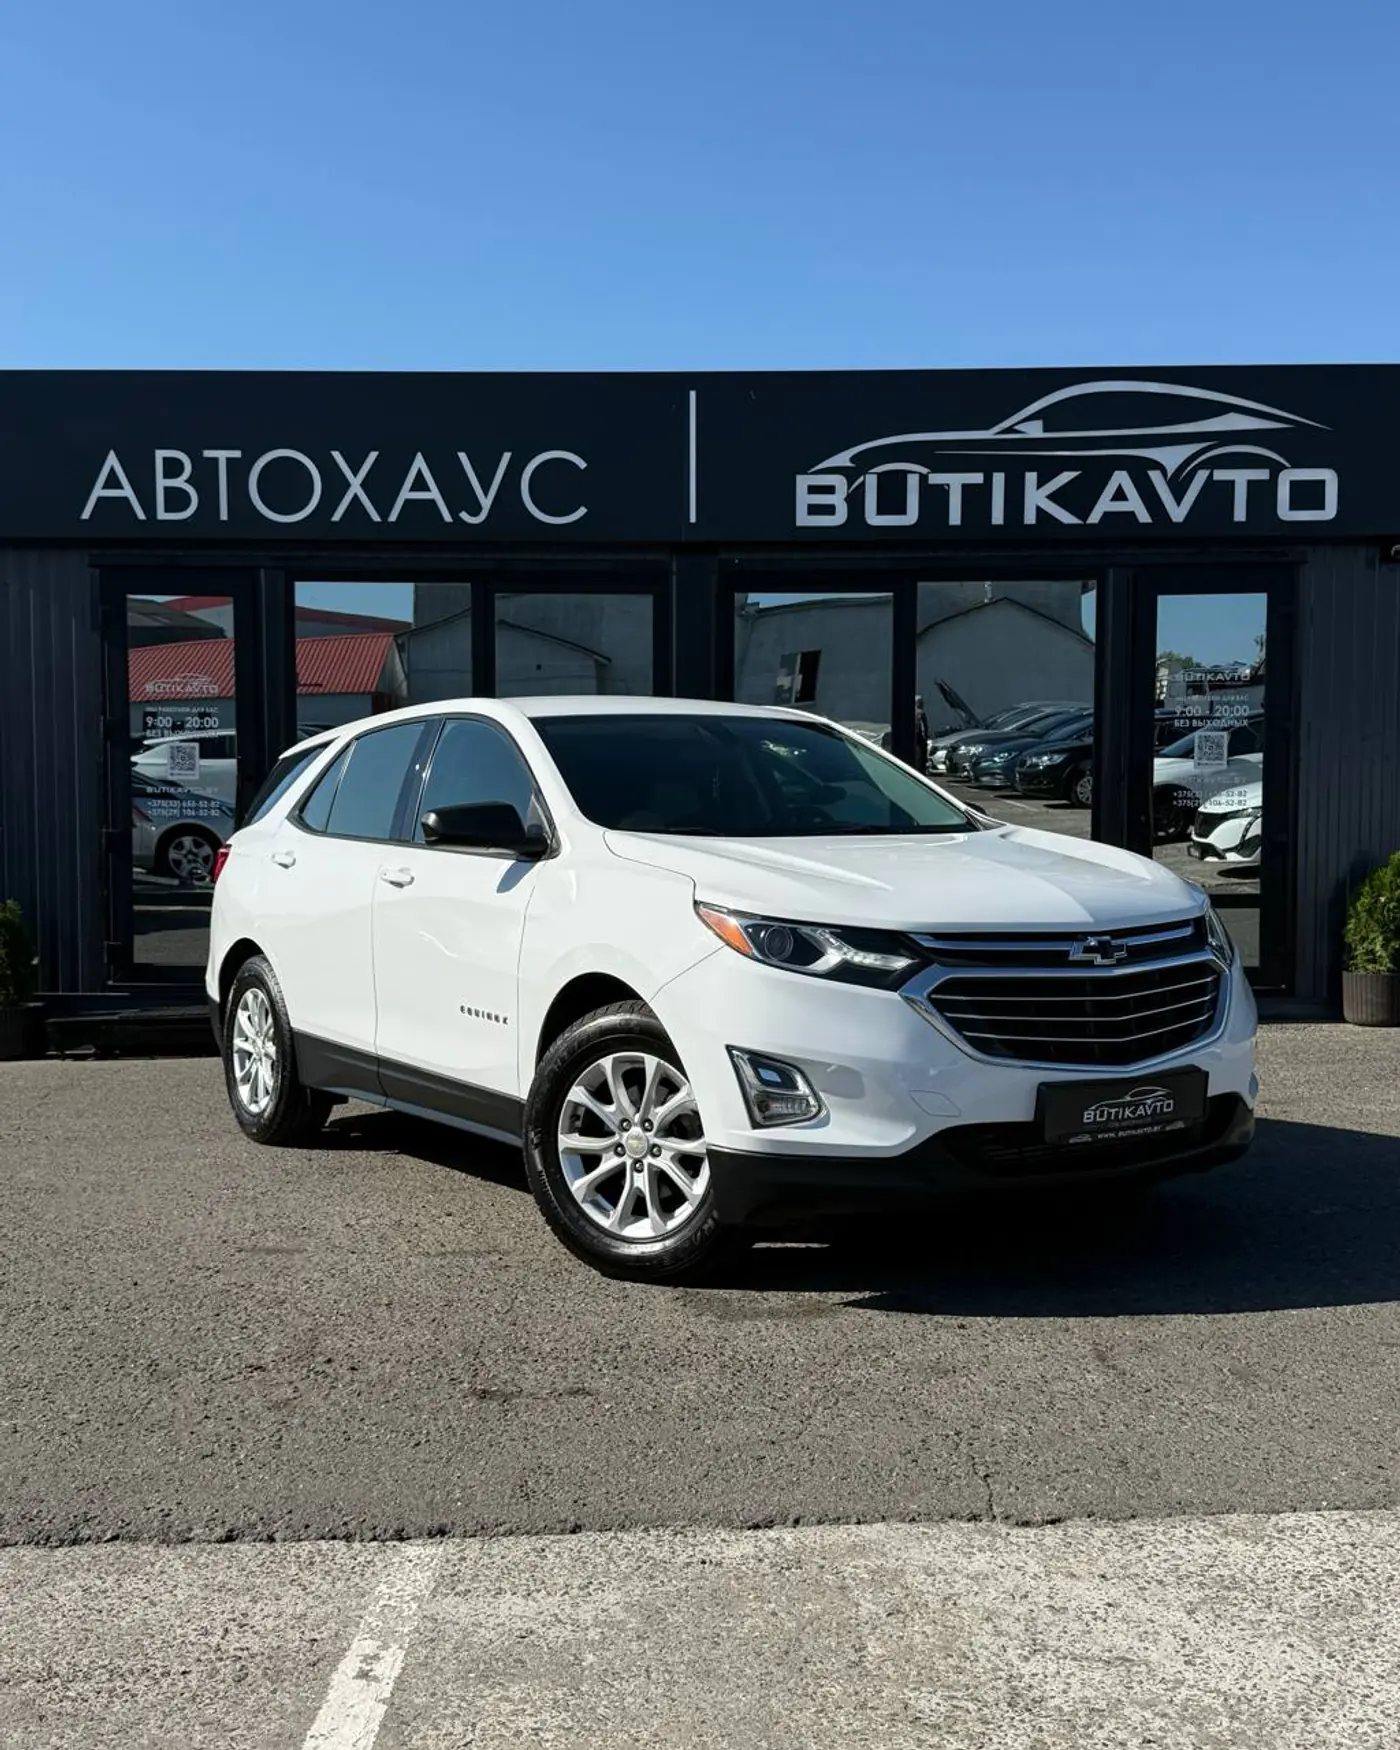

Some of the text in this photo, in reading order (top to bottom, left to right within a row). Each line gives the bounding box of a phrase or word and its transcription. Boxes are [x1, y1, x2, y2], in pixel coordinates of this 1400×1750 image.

[80, 448, 588, 525] АВТОХАУС
[795, 467, 1339, 528] BUTIKAVTO
[145, 716, 173, 728] 9:00
[184, 716, 220, 729] 20:00
[1174, 705, 1201, 717] 9:00
[1215, 705, 1250, 717] 20:00
[1083, 1099, 1174, 1123] BUTIKAVTO
